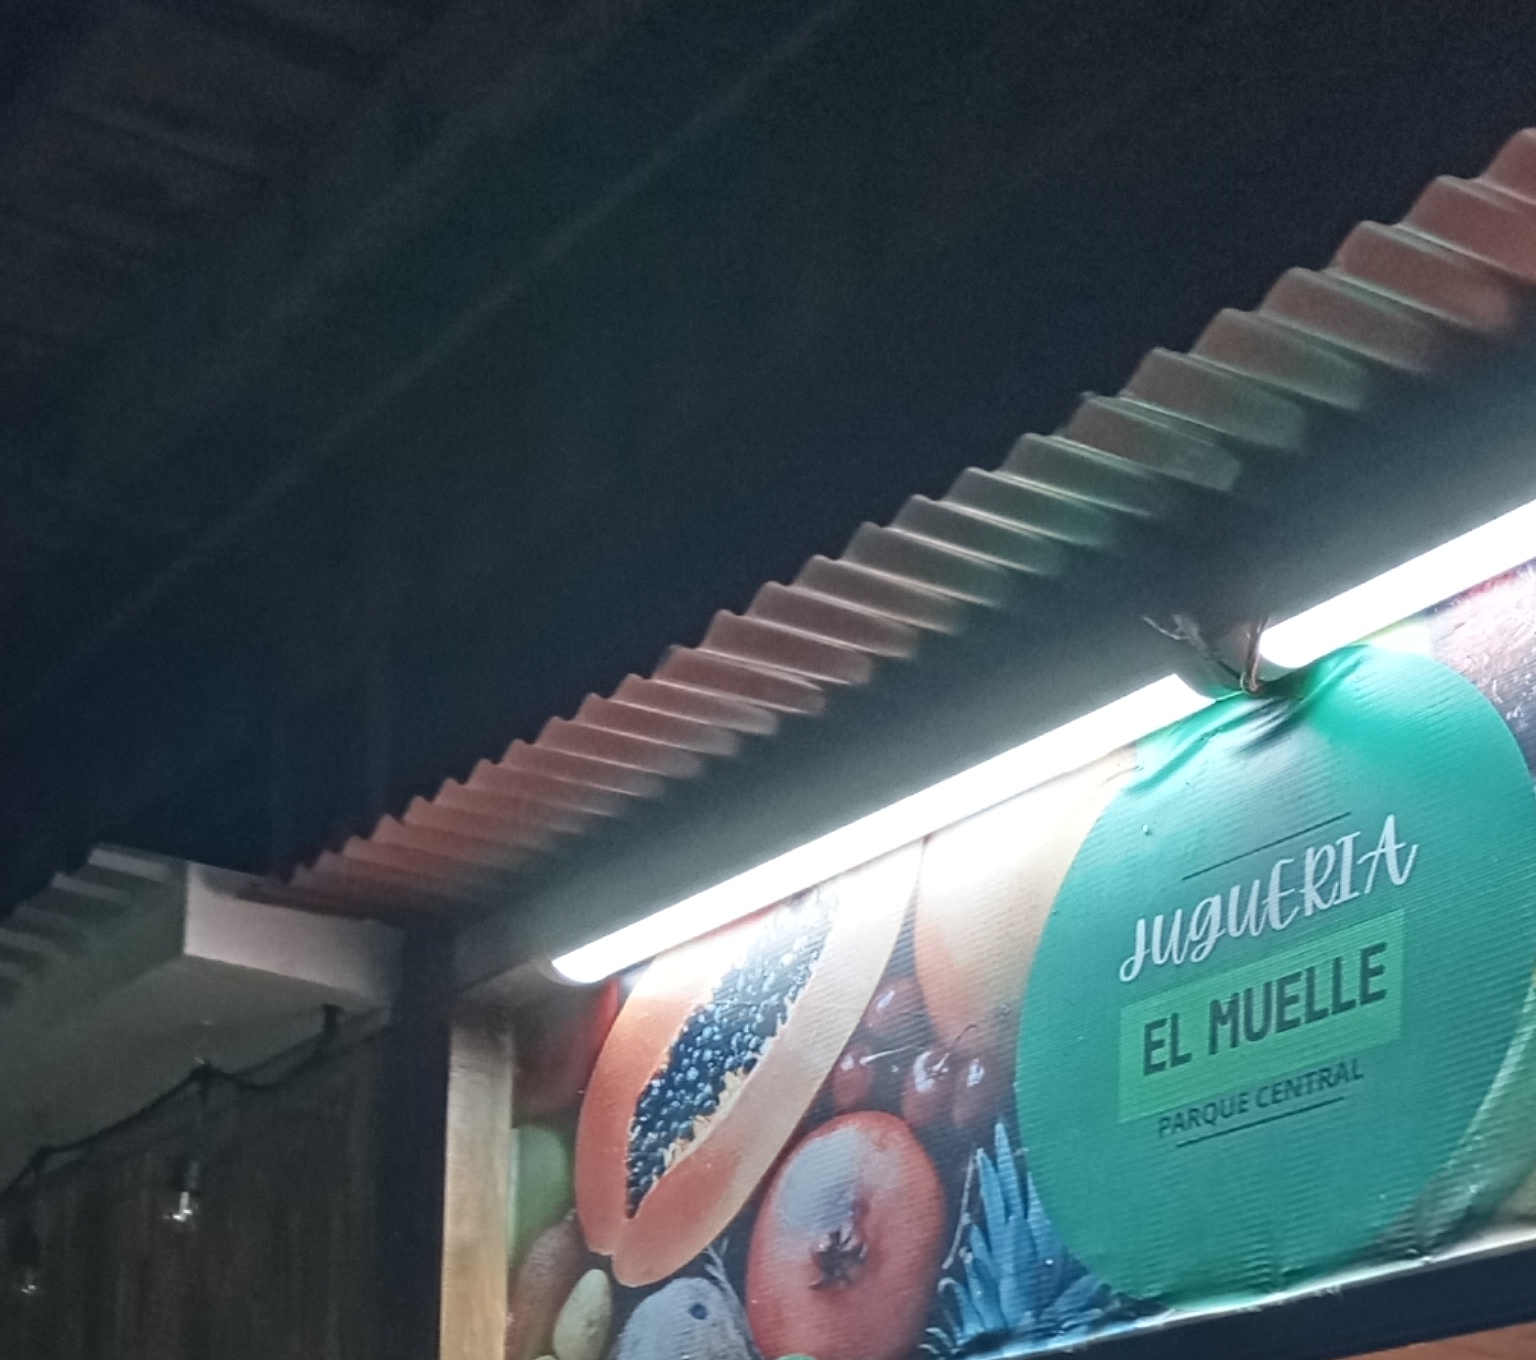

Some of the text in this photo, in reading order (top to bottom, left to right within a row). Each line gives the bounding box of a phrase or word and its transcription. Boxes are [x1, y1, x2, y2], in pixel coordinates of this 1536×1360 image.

[1142, 942, 1389, 1076] EL MUELLE
[1157, 1057, 1364, 1139] PARQUE CENTRAL
